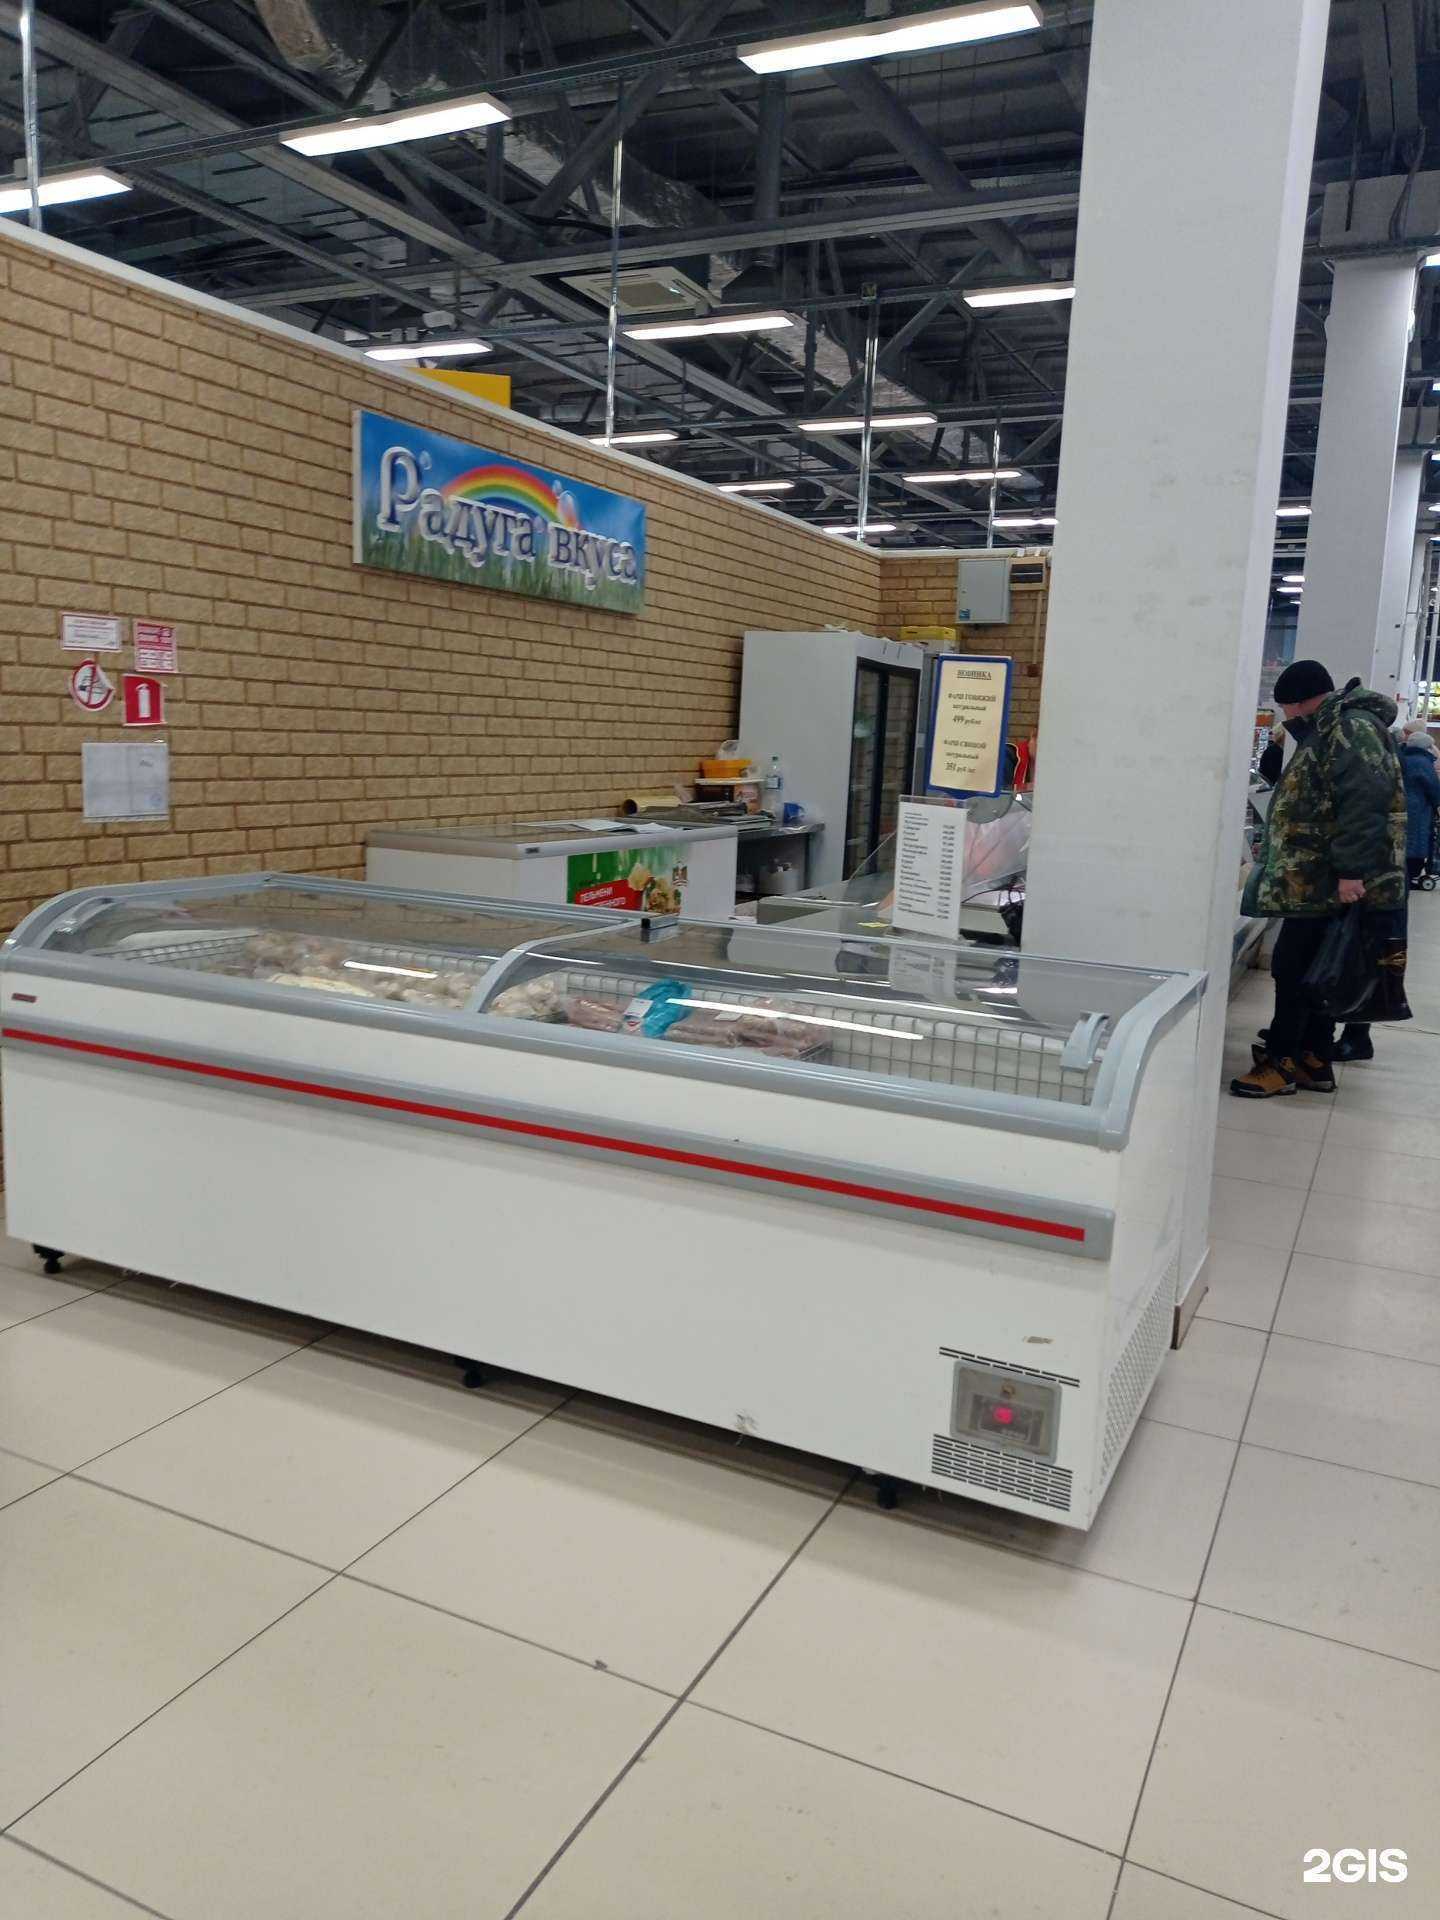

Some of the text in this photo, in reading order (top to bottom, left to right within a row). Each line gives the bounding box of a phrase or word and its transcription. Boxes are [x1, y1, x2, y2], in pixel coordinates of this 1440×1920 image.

[376, 446, 638, 591] Радуга вкуса
[957, 669, 992, 680] НОВИНКА
